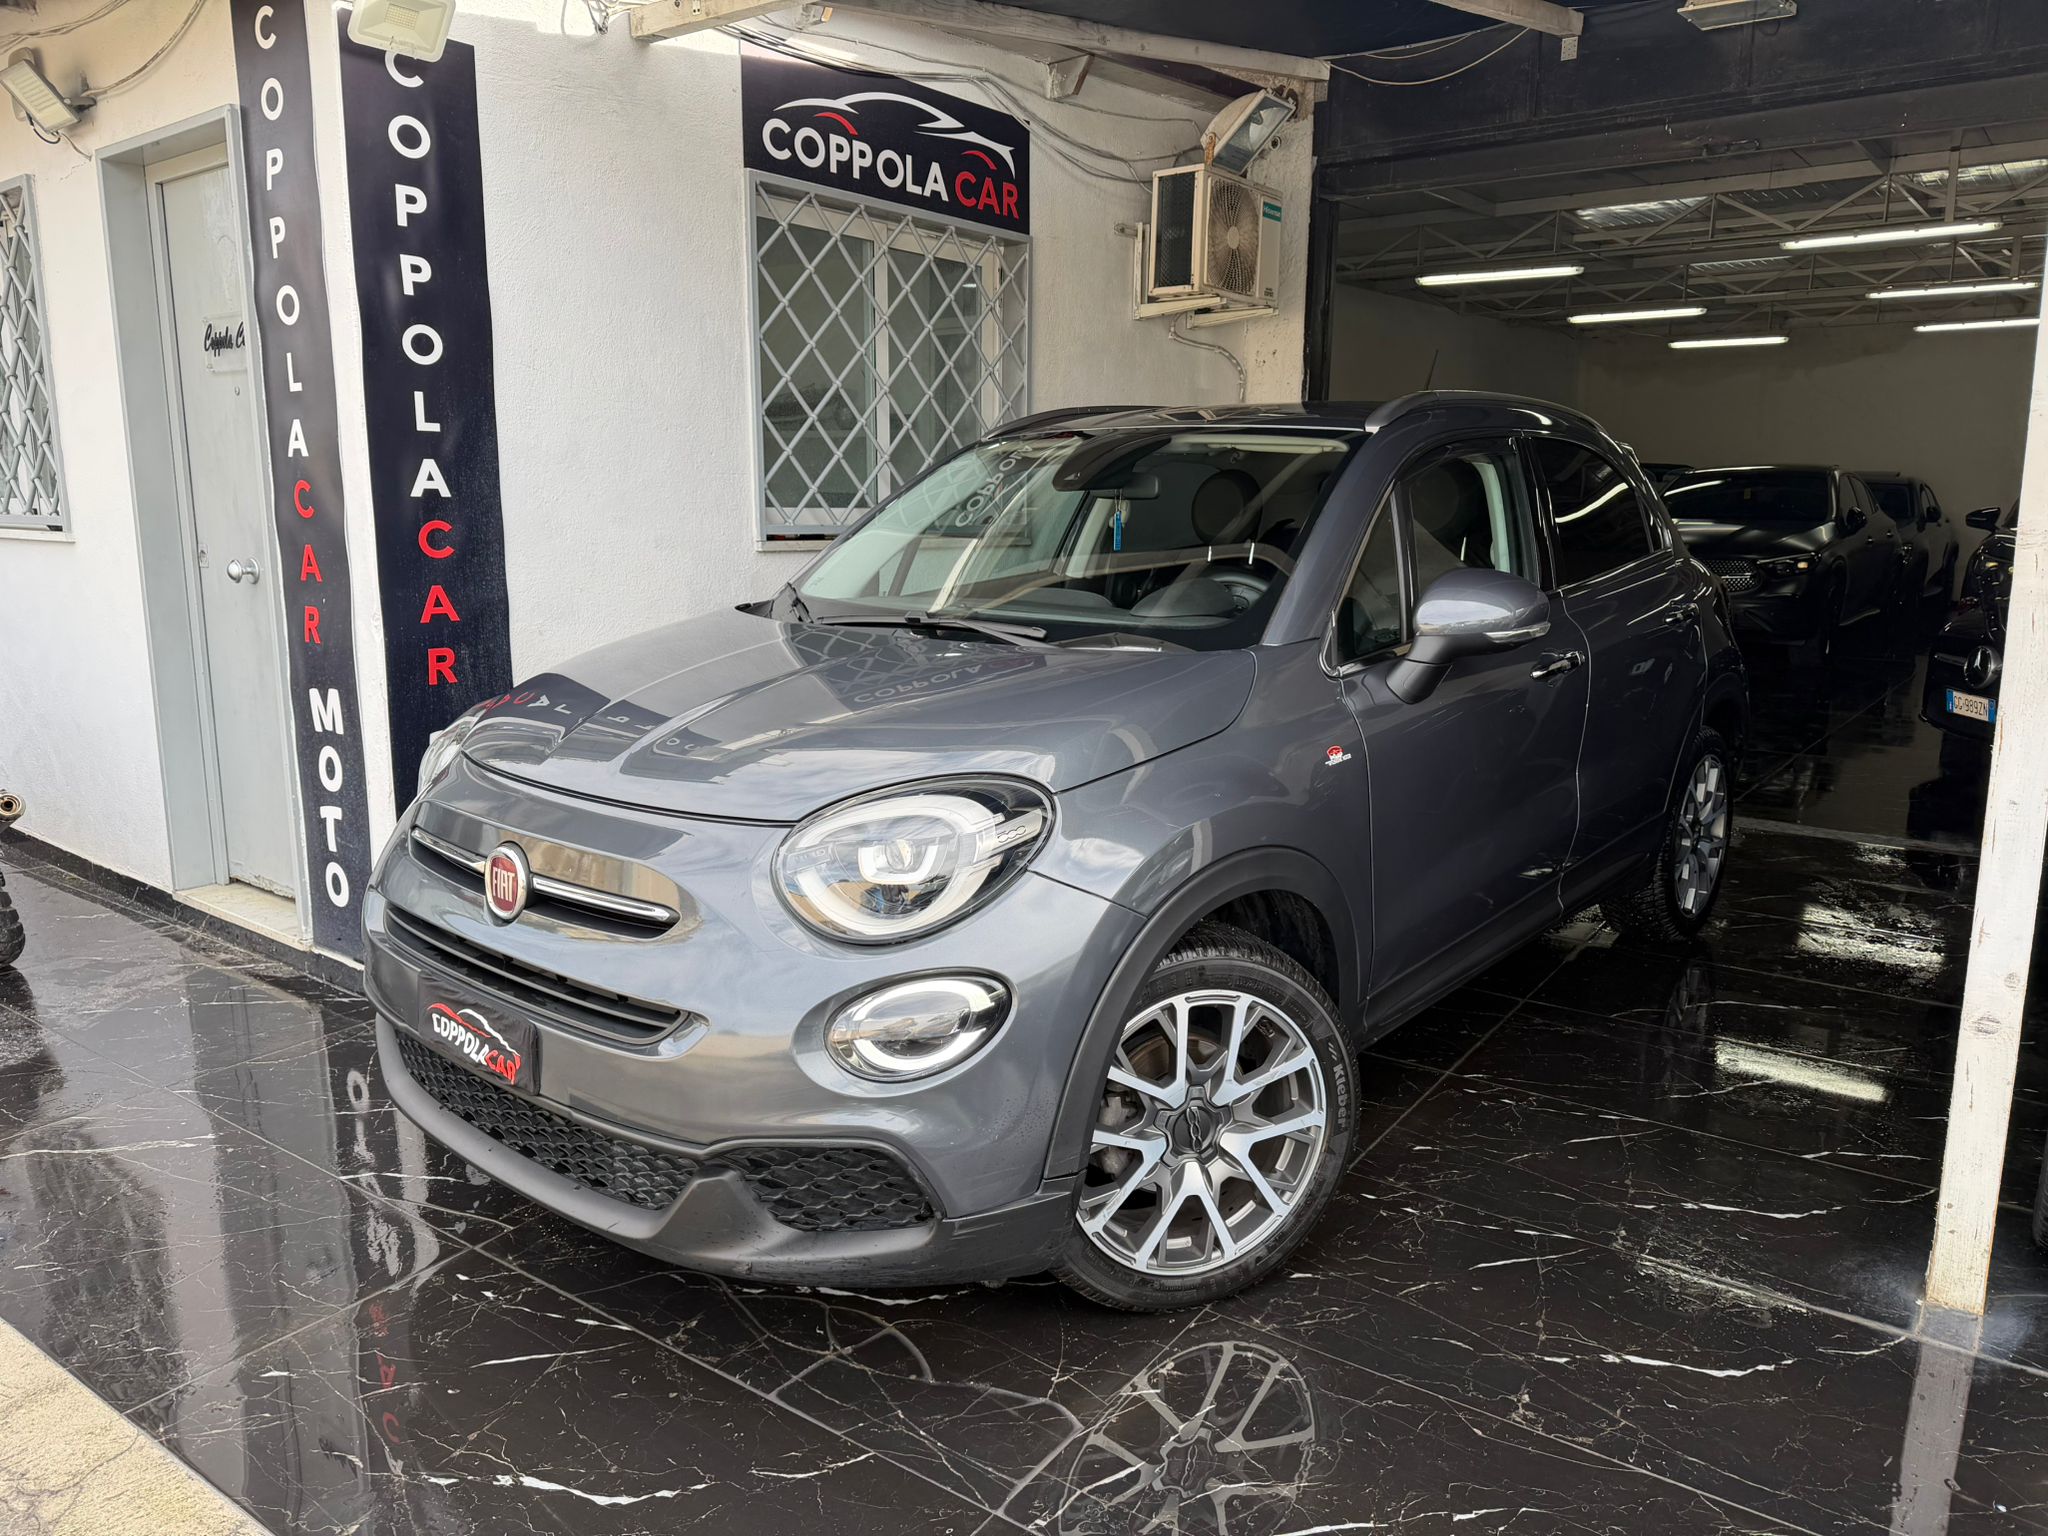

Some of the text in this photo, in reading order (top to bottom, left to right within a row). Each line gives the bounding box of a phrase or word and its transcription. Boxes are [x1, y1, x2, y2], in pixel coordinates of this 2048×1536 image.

[762, 118, 1019, 219] COPPOLA CAR
[309, 688, 349, 908] MOTO
[493, 866, 516, 903] FIAT
[1333, 1063, 1348, 1128] Kleber
